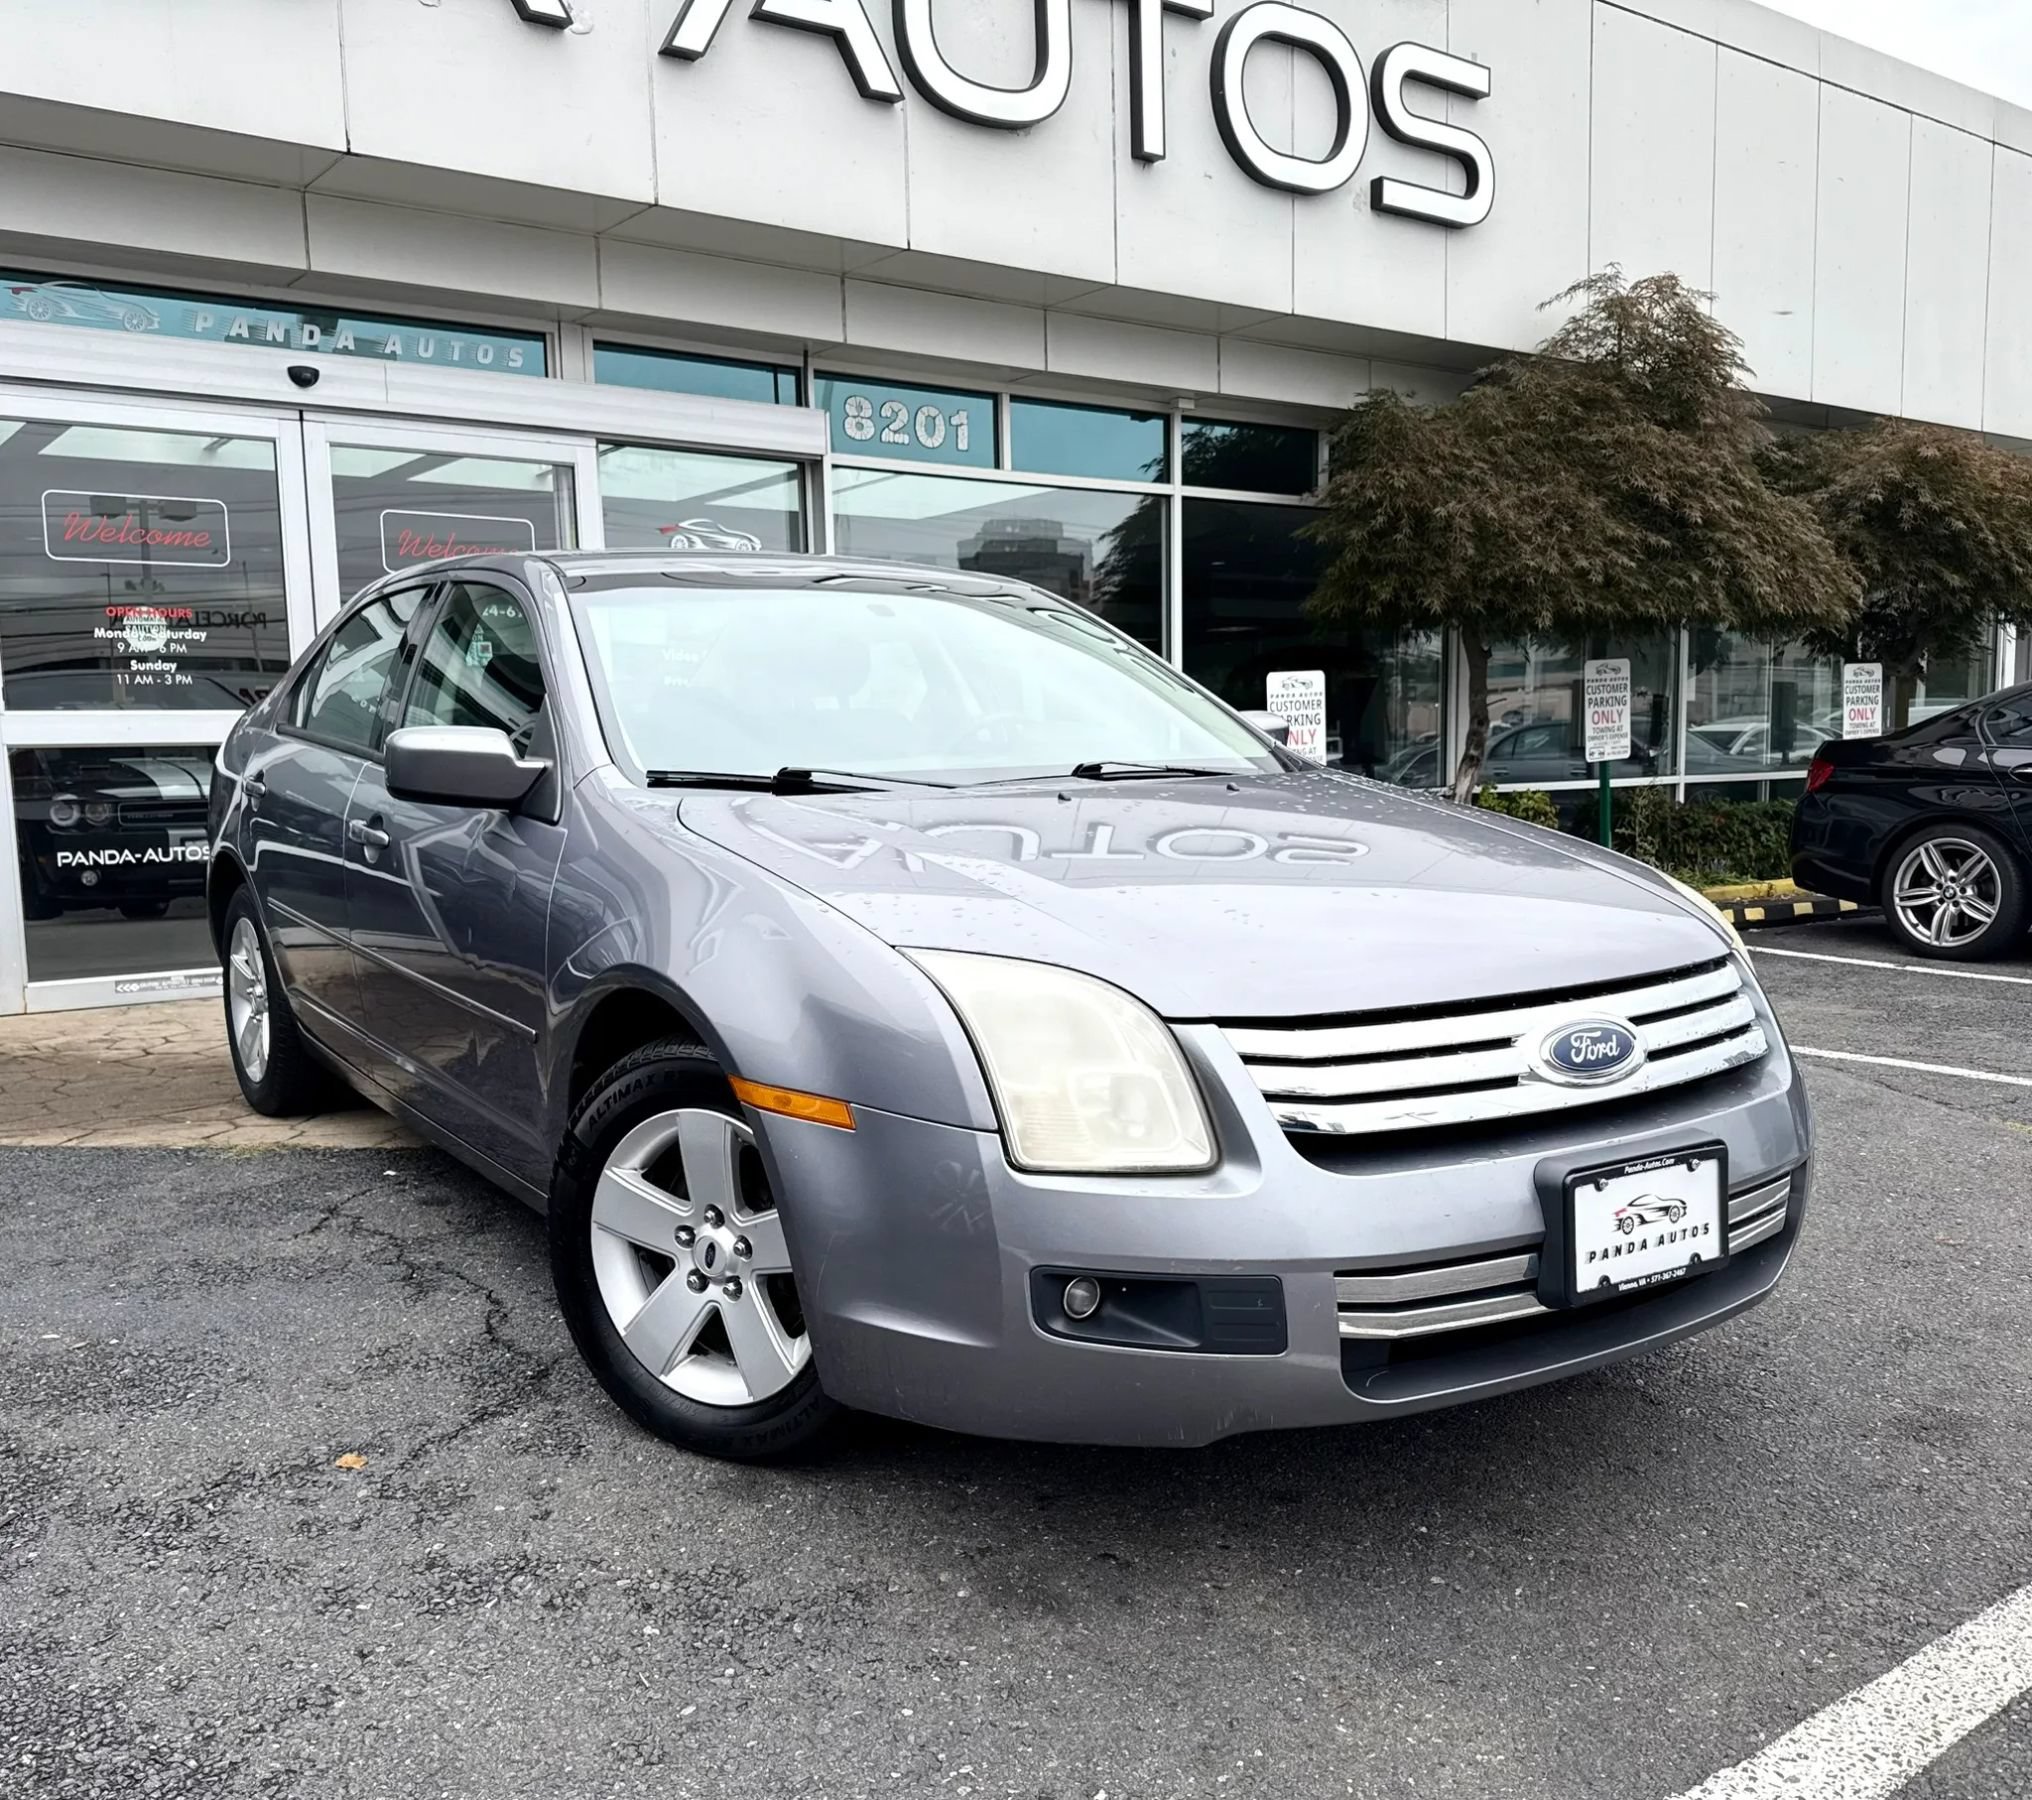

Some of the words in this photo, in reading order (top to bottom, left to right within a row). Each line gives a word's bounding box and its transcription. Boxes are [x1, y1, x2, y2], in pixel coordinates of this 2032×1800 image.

[658, 0, 1495, 228] AUTOS
[194, 311, 356, 350] PANDA
[384, 334, 524, 368] AUTOS
[843, 394, 969, 452] 8201
[63, 511, 213, 548] Welcome
[117, 642, 125, 653] 9
[159, 642, 167, 653] 6
[170, 643, 187, 653] PM
[130, 660, 177, 673] Sunday
[116, 674, 129, 685] 11
[134, 675, 153, 685] AM
[164, 675, 172, 685] 3
[176, 675, 193, 685] PM
[1586, 683, 1628, 695] CUSTOMER
[1845, 684, 1880, 694] CUSTOMER
[1269, 699, 1322, 713] CUSTOMER
[1588, 695, 1627, 708] PARKING
[1846, 695, 1879, 706] PARKING
[1281, 713, 1321, 727] RKING
[1591, 709, 1623, 725] ONLY
[1848, 707, 1876, 721] ONLY
[1288, 728, 1317, 746] NLY
[1570, 1031, 1620, 1063] Ford
[587, 1073, 657, 1132] ALTIMAX
[1588, 1238, 1648, 1264] PANDA
[1657, 1222, 1710, 1247] AUTOS
